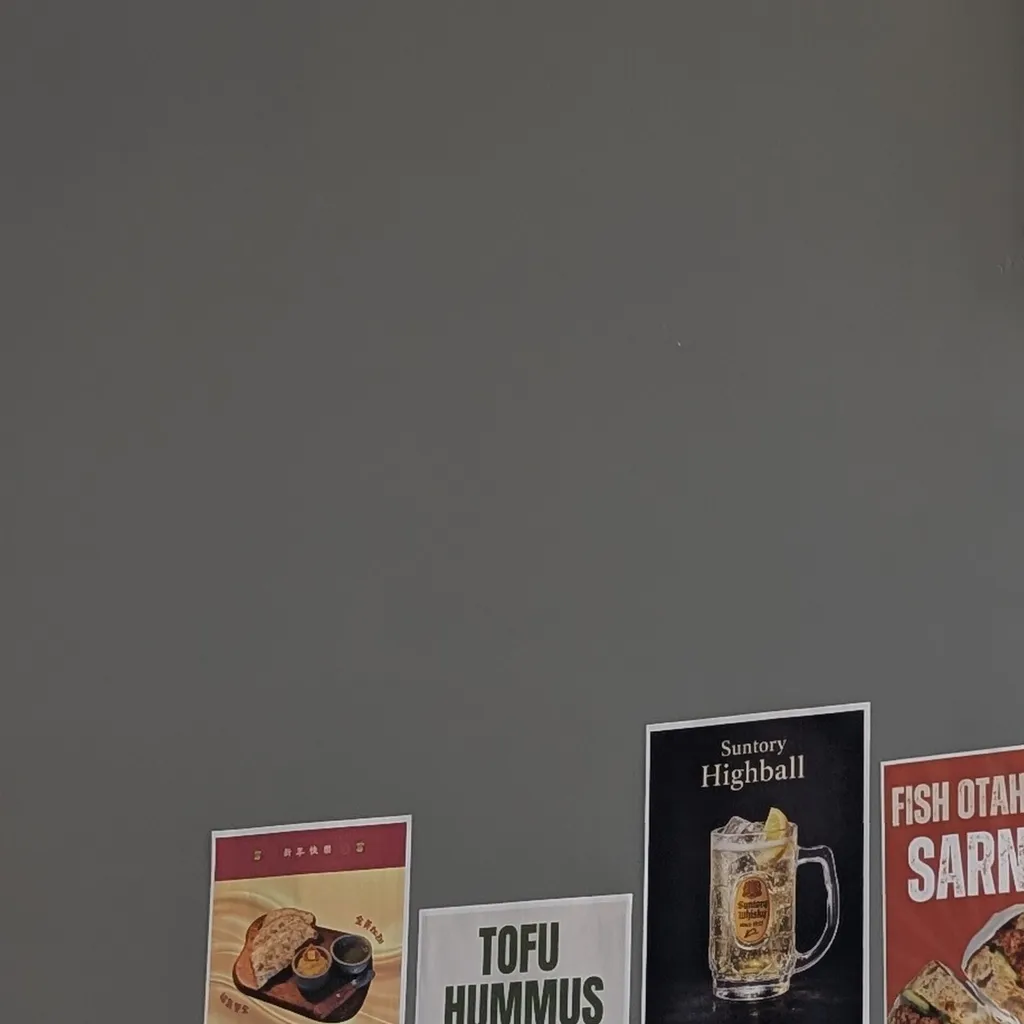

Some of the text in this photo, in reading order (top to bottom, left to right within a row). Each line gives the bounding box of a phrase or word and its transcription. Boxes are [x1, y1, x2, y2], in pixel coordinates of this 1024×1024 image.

[721, 739, 787, 757] Suntory
[701, 754, 805, 791] Highball
[892, 781, 950, 826] FISH
[479, 922, 559, 975] TOFU
